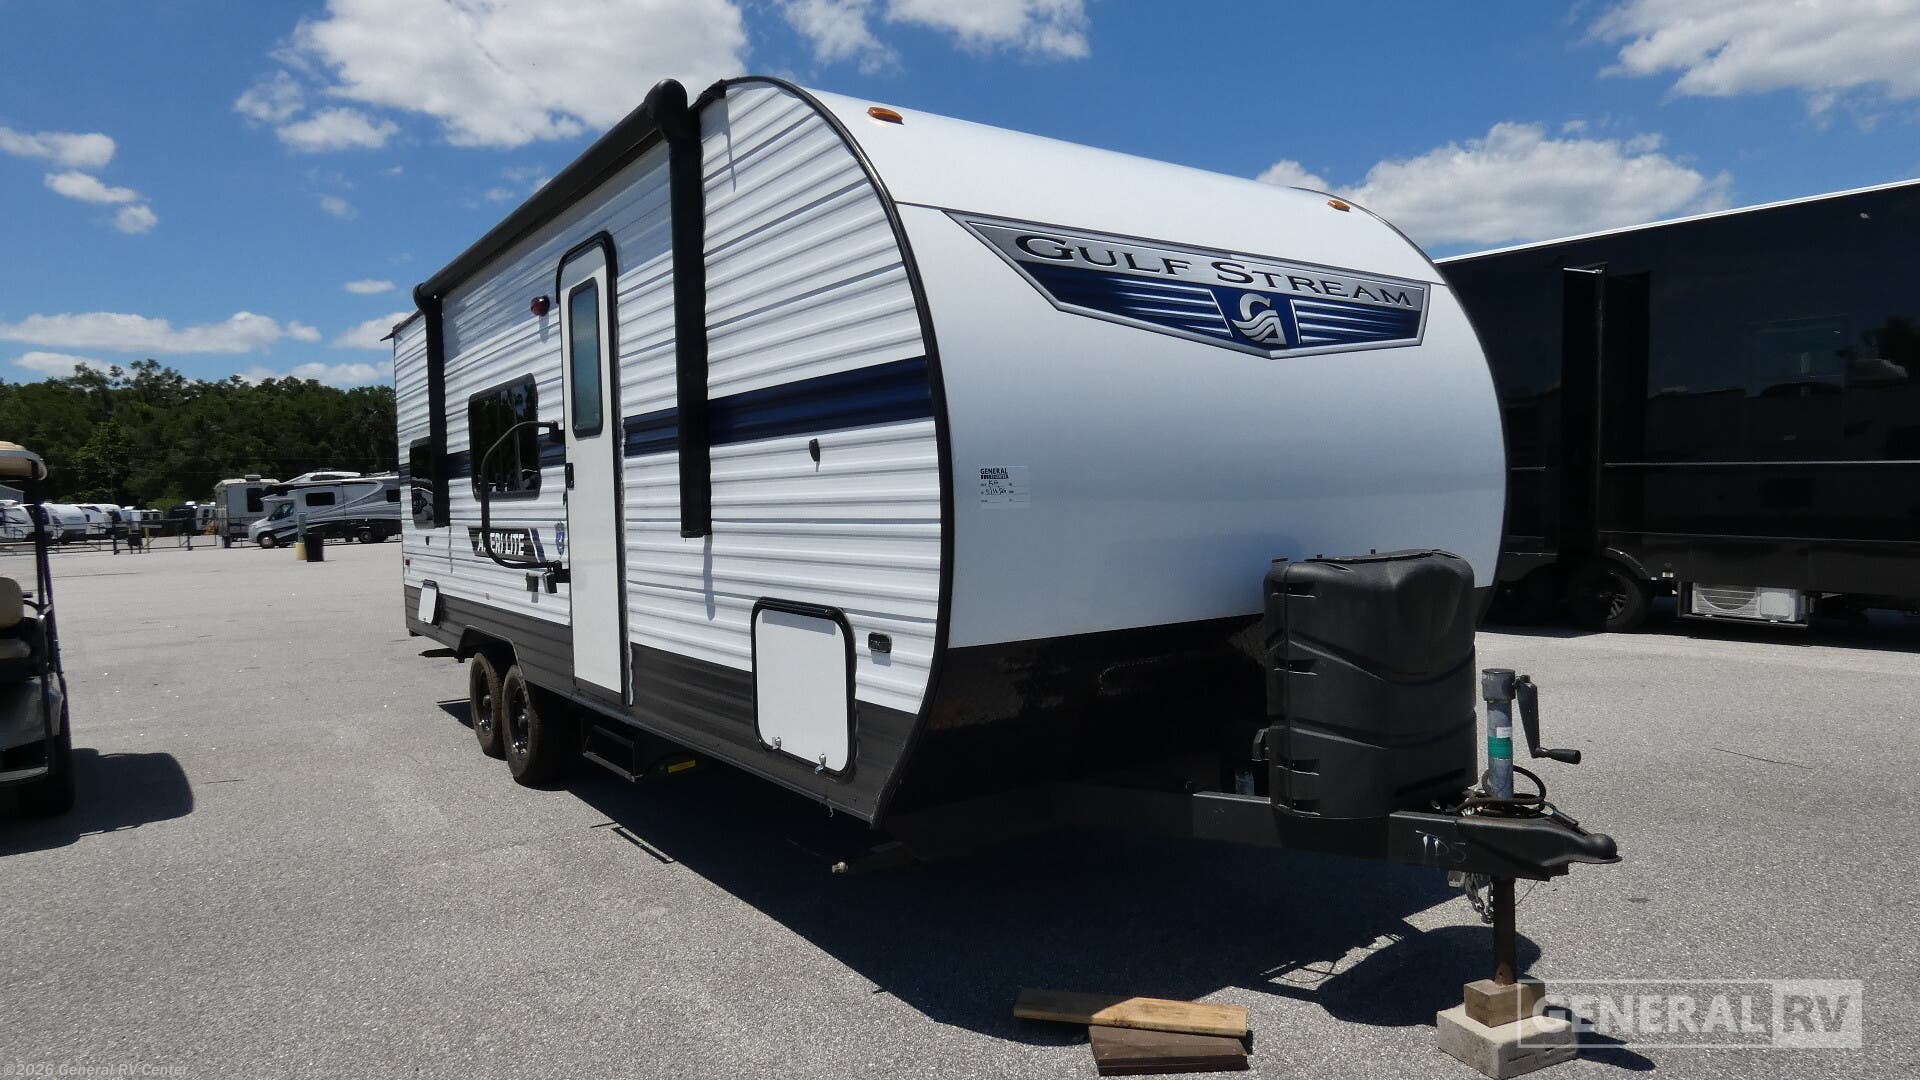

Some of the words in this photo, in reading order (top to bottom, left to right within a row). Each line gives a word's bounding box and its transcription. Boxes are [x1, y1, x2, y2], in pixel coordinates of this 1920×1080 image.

[1015, 234, 1193, 276] GULF
[1210, 261, 1414, 308] STREAM
[980, 467, 1008, 475] GENERAL
[477, 531, 503, 554] AERI
